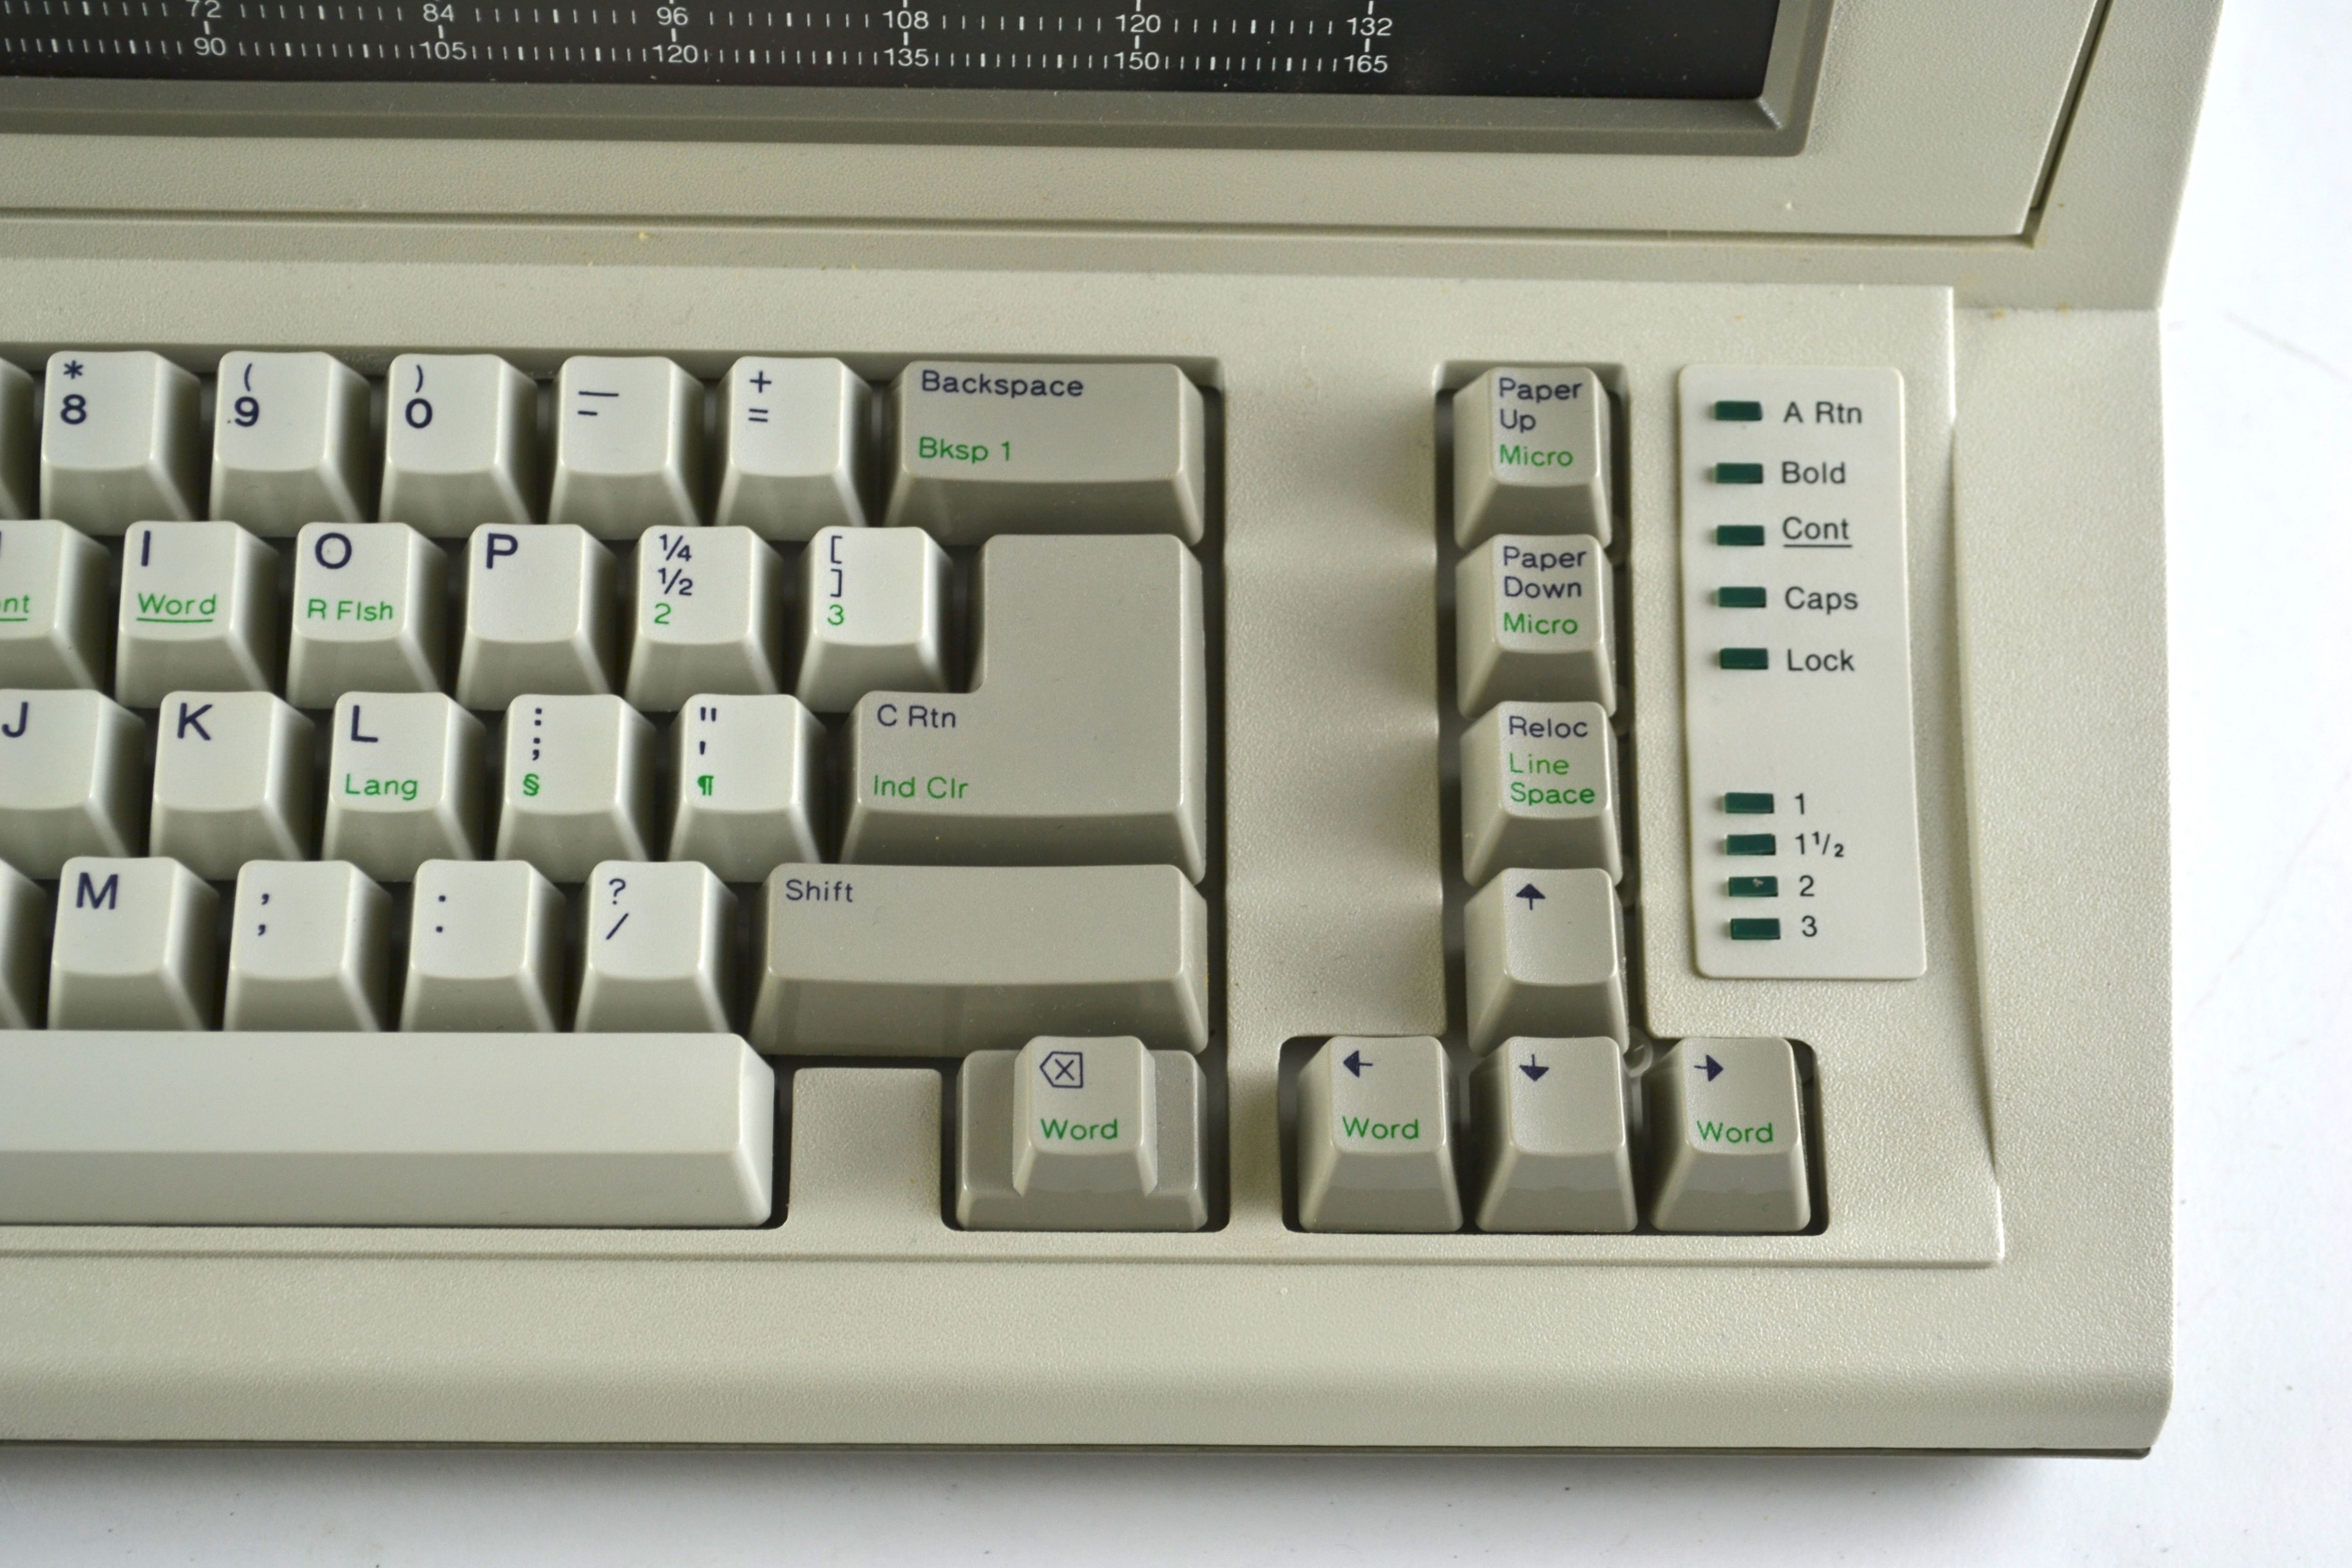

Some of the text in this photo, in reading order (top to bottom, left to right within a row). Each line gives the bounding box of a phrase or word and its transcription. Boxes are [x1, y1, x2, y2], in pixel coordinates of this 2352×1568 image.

[186, 0, 1392, 36] 72 84 96 108 120 132
[194, 37, 1387, 72] 90 105 120 135 150 165
[244, 363, 252, 391] (
[415, 365, 424, 393] )
[750, 371, 772, 393] +
[922, 370, 1084, 398] Backspace
[1500, 378, 1582, 403] Paper
[61, 394, 87, 425] 8
[235, 397, 259, 427] 9
[749, 408, 768, 422] =
[1501, 409, 1536, 433] Up
[1784, 401, 1861, 424] A Rtn
[919, 436, 1010, 463] Bksp 1
[1501, 445, 1574, 467] Micro
[1782, 461, 1845, 484] Bold
[1782, 517, 1852, 548] Cont
[141, 530, 151, 567] I
[315, 532, 352, 569] O
[486, 533, 518, 569] P
[830, 535, 842, 564] [
[1504, 546, 1586, 571] Paper
[830, 569, 842, 598] ]
[1505, 576, 1582, 598] Down
[0, 595, 30, 614] nt
[137, 593, 217, 616] Word
[308, 599, 393, 621] R Flsh
[1785, 586, 1858, 615] Caps
[654, 603, 671, 624] 2
[827, 604, 844, 626] 3
[1505, 612, 1578, 635] Micro
[1787, 649, 1854, 671] Lock
[2, 702, 29, 738] J
[178, 703, 212, 741] K
[351, 705, 378, 743] L
[534, 708, 542, 726] :
[877, 704, 955, 728] C Rtn
[1510, 716, 1588, 739] Reloc
[533, 738, 540, 761] ;
[1510, 753, 1570, 775] Line
[346, 774, 418, 801] Lang
[523, 773, 540, 796] §
[697, 775, 714, 796] ¶
[874, 775, 968, 799] Ind Clr
[1512, 782, 1595, 805] Space
[1795, 793, 1804, 814] 1
[77, 872, 118, 910] M
[609, 878, 626, 904] ?
[786, 879, 852, 902] Shift
[1800, 875, 1814, 897] 2
[606, 913, 628, 940] /
[1802, 915, 1817, 937] 3
[1041, 1119, 1118, 1140] Word
[1343, 1117, 1419, 1140] Word
[1697, 1121, 1774, 1143] Word
